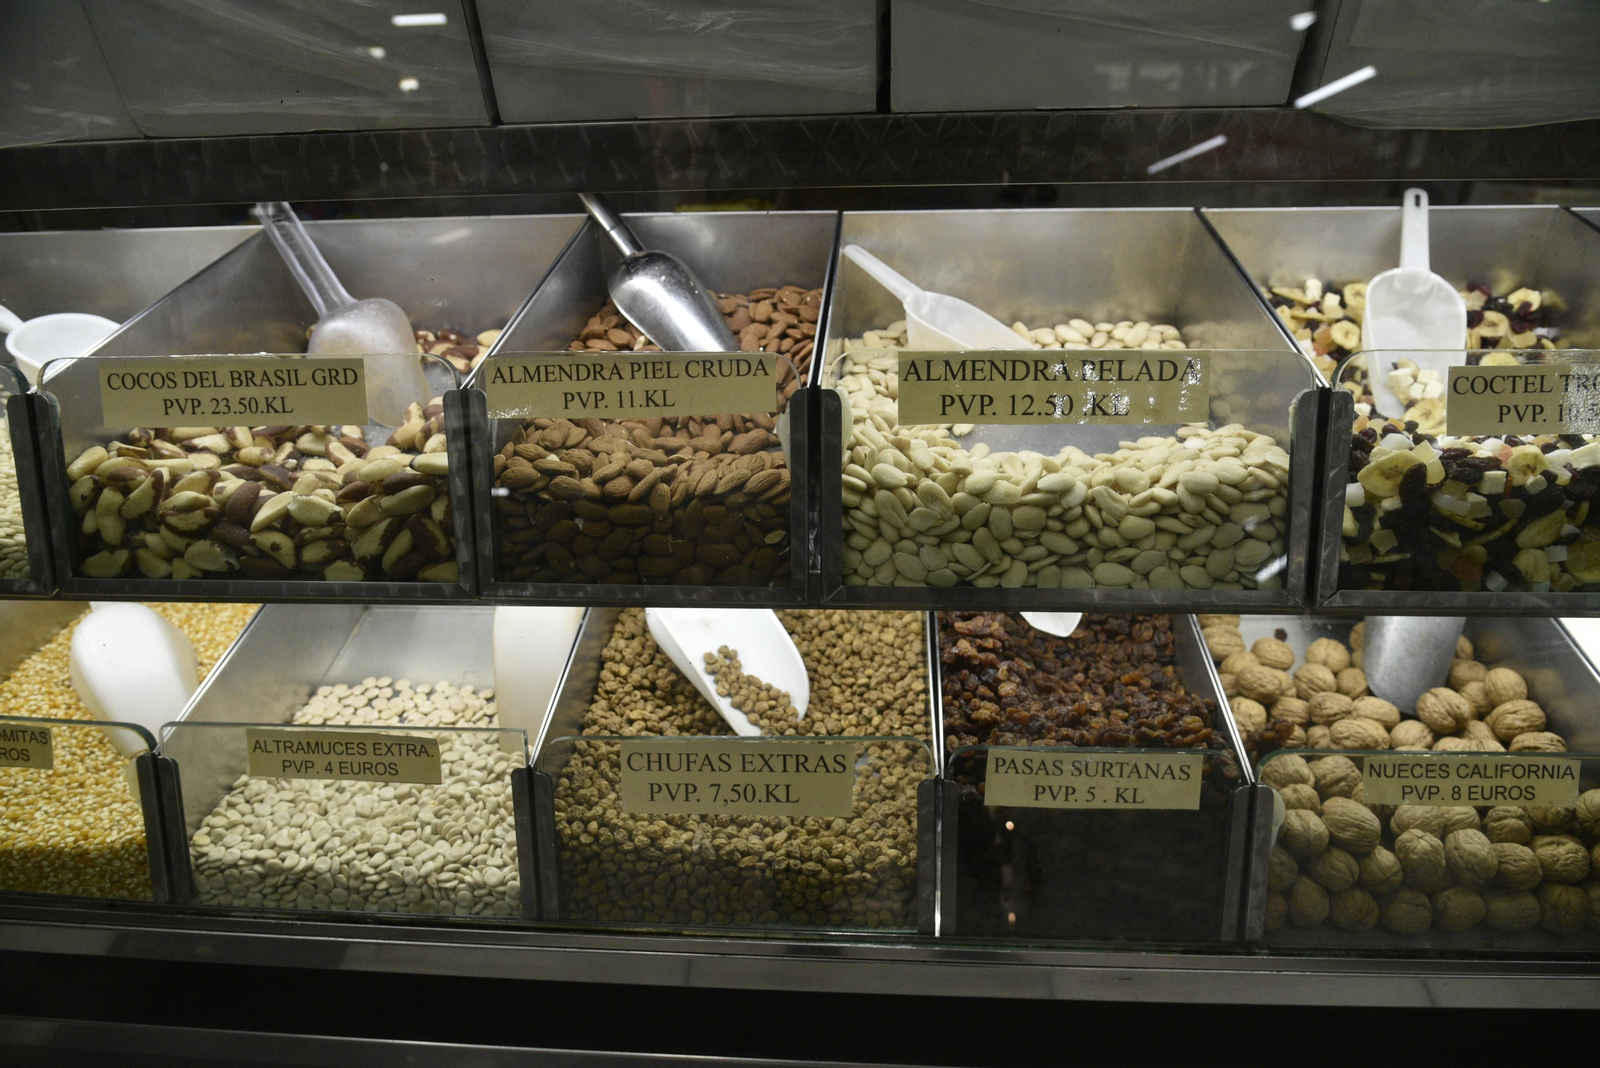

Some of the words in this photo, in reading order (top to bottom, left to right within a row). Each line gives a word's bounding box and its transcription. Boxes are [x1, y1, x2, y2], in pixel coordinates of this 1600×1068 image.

[107, 372, 178, 390] COCOS
[184, 370, 225, 389] DEL
[229, 368, 307, 388] BRASIL
[311, 367, 358, 386] GRD
[491, 362, 624, 384] ALMENDRA
[629, 360, 679, 380] PIEL
[684, 358, 770, 379] CRUDA
[902, 359, 1073, 382] ALMENDRA
[1080, 359, 1201, 382] PELADA
[1452, 374, 1554, 395] COCTEL
[163, 398, 205, 416] PVP.
[210, 397, 294, 415] 23.50.KL
[562, 391, 608, 410] PVP.
[617, 389, 676, 408] 11.KL
[939, 394, 997, 416] PVP.
[1009, 394, 1074, 416] 12.50
[1497, 404, 1547, 423] PVP.
[0, 728, 48, 745] MITAS
[253, 739, 367, 756] ALTRAMUCES
[372, 742, 434, 758] EXTRA.
[282, 760, 320, 774] PVP.
[324, 761, 334, 774] 4
[339, 761, 399, 776] EUROS
[626, 752, 732, 773] CHUFAS
[739, 753, 847, 774] EXTRAS
[993, 756, 1064, 776] PASAS
[1070, 759, 1191, 781] SURTANAS
[1369, 763, 1450, 779] NUECES
[1456, 763, 1575, 780] CALIFORNIA
[648, 782, 700, 803] PVP.
[709, 783, 800, 807] 7,50.KL
[1033, 784, 1078, 802] PVP.
[1402, 785, 1445, 801] PVP.
[1451, 786, 1462, 801] 8
[1467, 785, 1536, 801] EUROS
